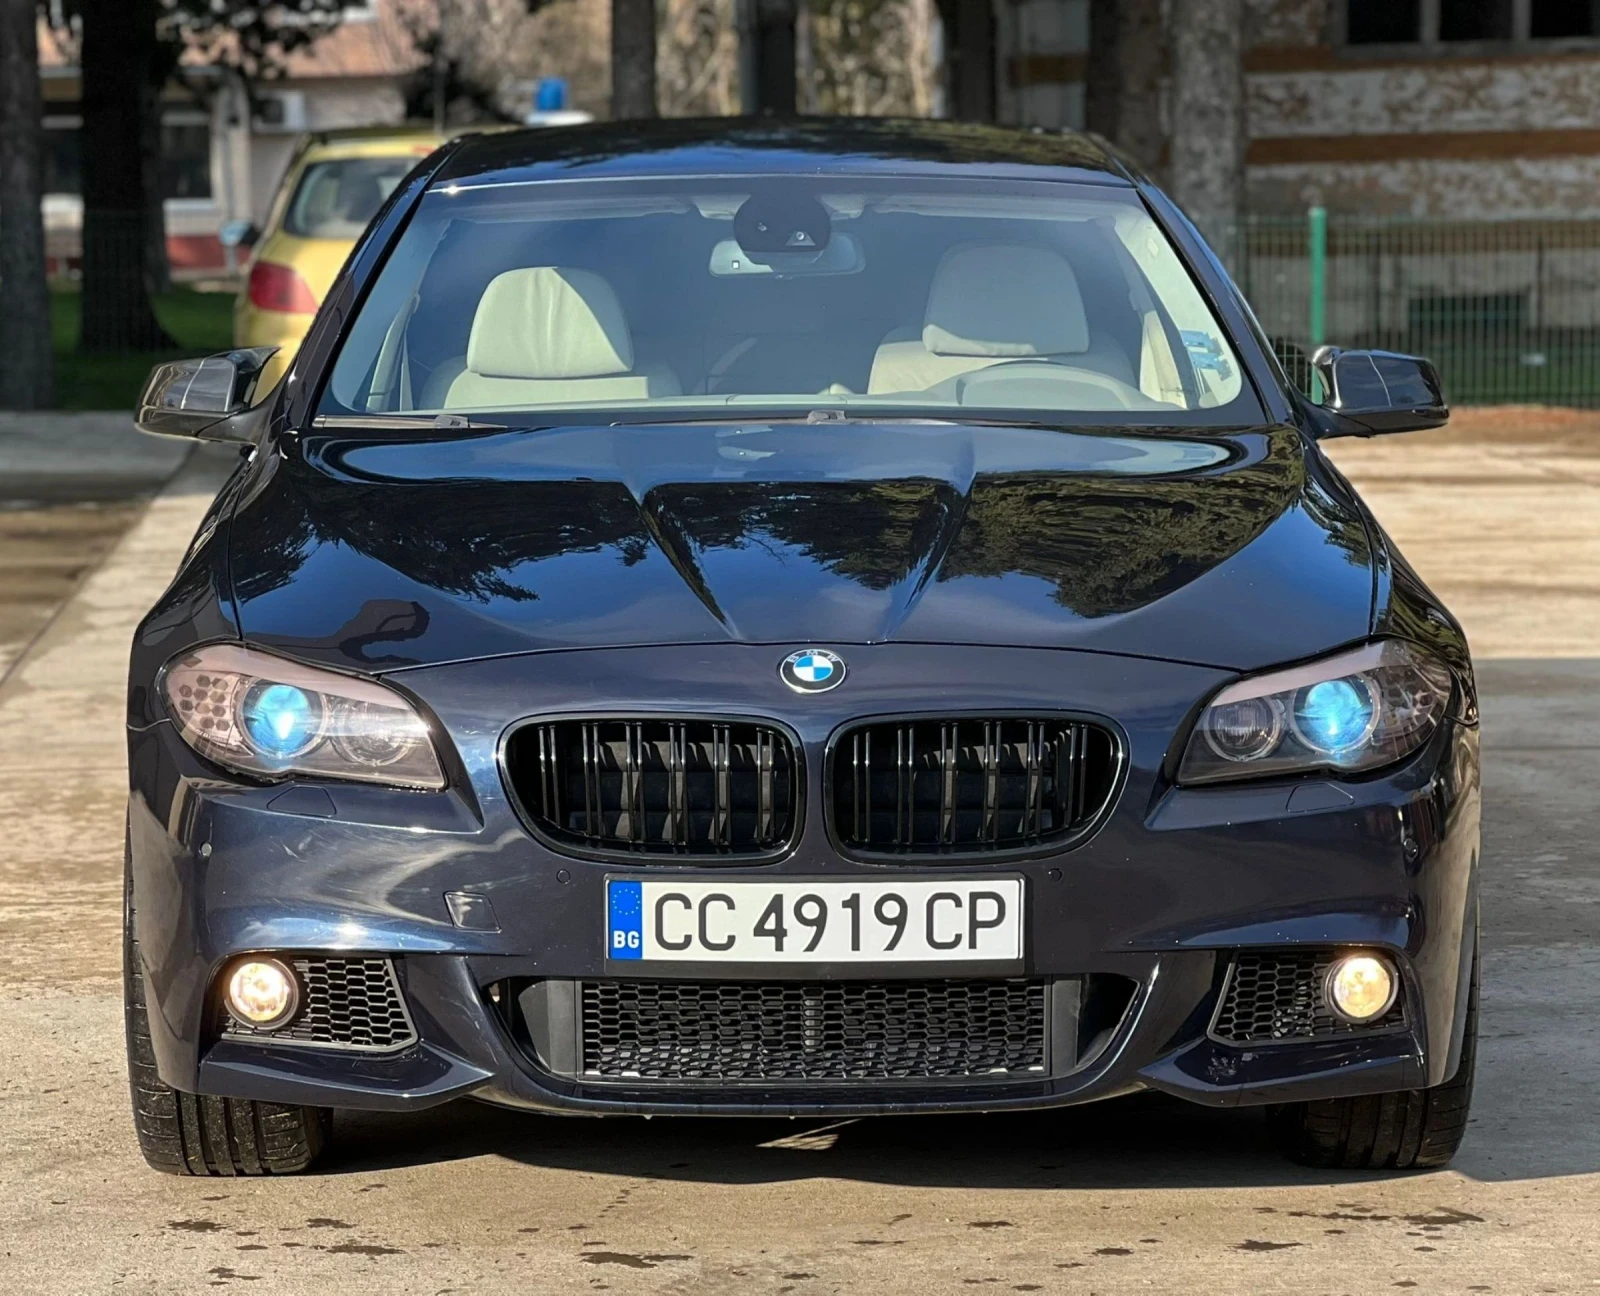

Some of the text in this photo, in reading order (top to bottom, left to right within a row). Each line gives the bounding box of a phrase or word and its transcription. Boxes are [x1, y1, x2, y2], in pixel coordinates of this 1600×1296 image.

[786, 649, 840, 663] BMW
[655, 891, 1006, 952] CC 4919 CP
[613, 930, 640, 949] BG
